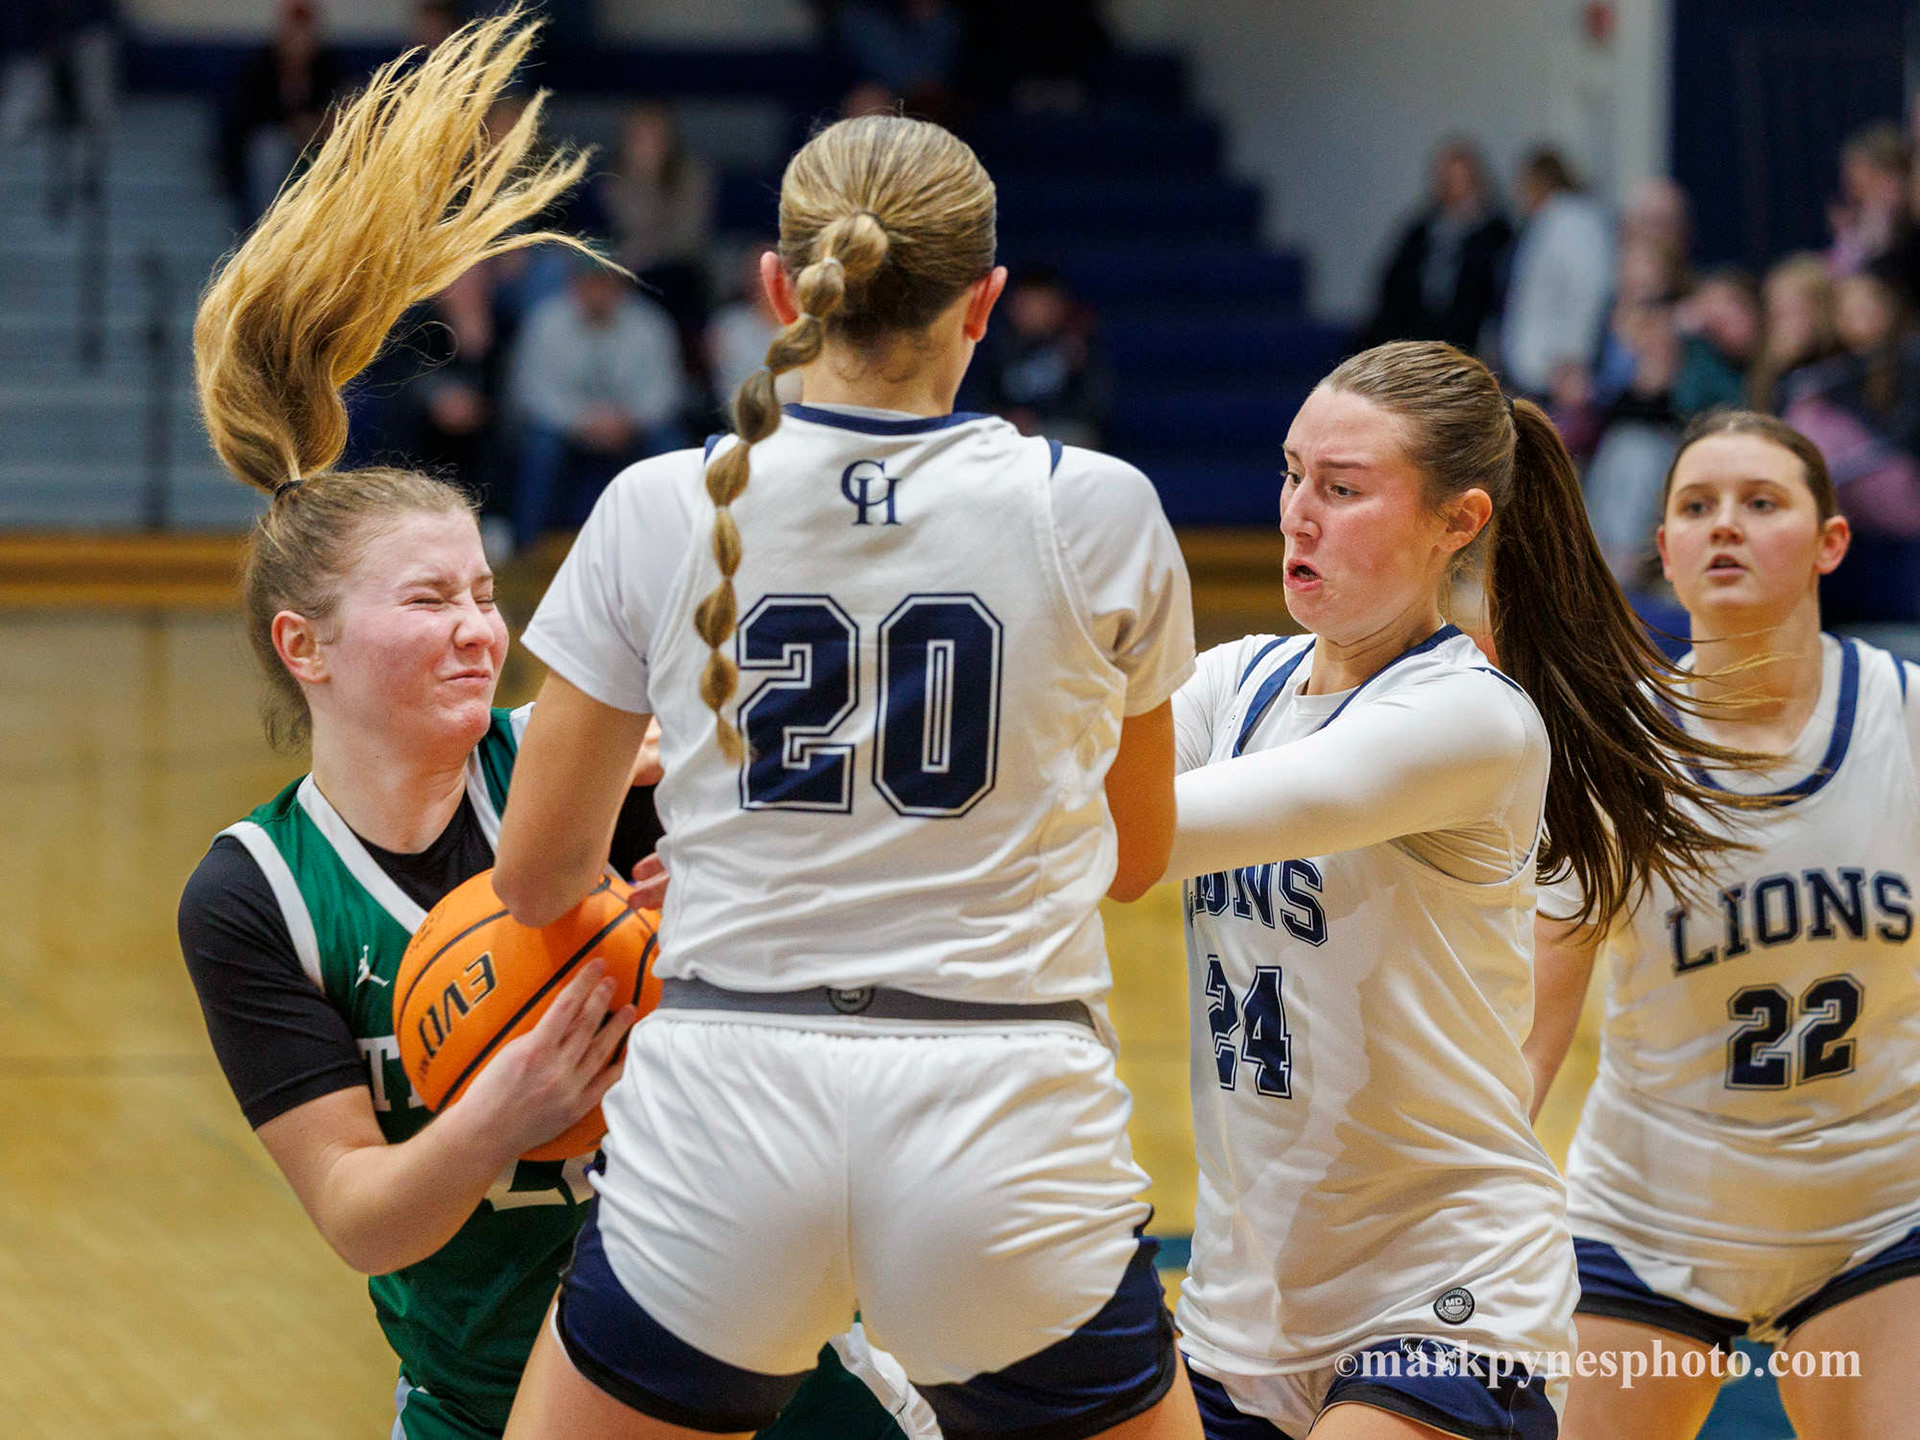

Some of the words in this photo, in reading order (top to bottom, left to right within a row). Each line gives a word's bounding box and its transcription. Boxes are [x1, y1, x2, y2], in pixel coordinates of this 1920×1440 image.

[737, 592, 1004, 819] 20
[1664, 866, 1915, 978] LIONS
[417, 950, 499, 1060] EVO
[1205, 953, 1293, 1100] 24
[1724, 972, 1865, 1092] 22
